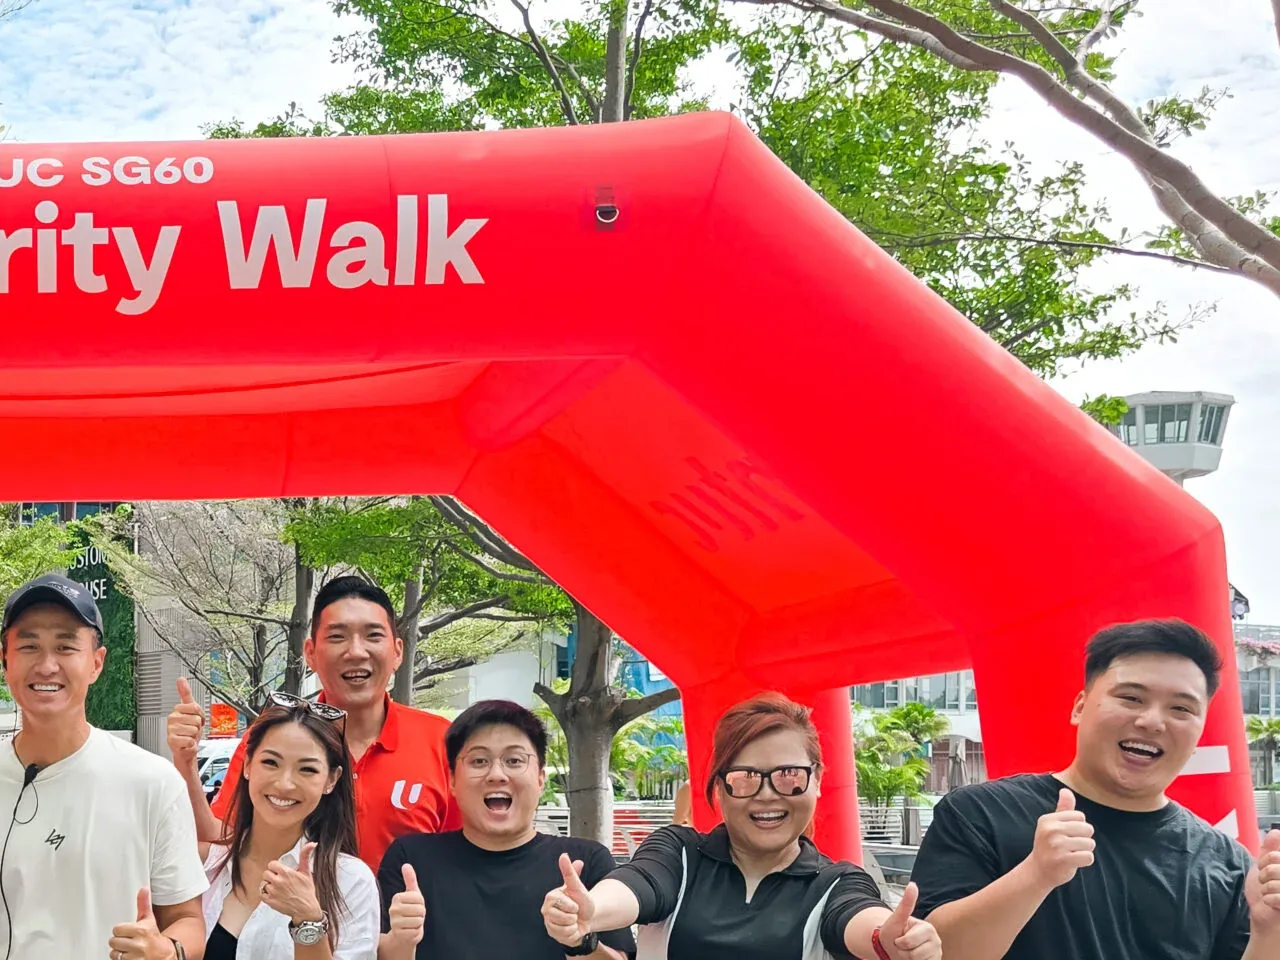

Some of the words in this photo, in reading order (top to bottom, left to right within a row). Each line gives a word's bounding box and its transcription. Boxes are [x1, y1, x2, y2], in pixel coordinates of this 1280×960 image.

[81, 156, 214, 186] SG60
[217, 194, 490, 289] Walk
[66, 546, 110, 570] USTOM
